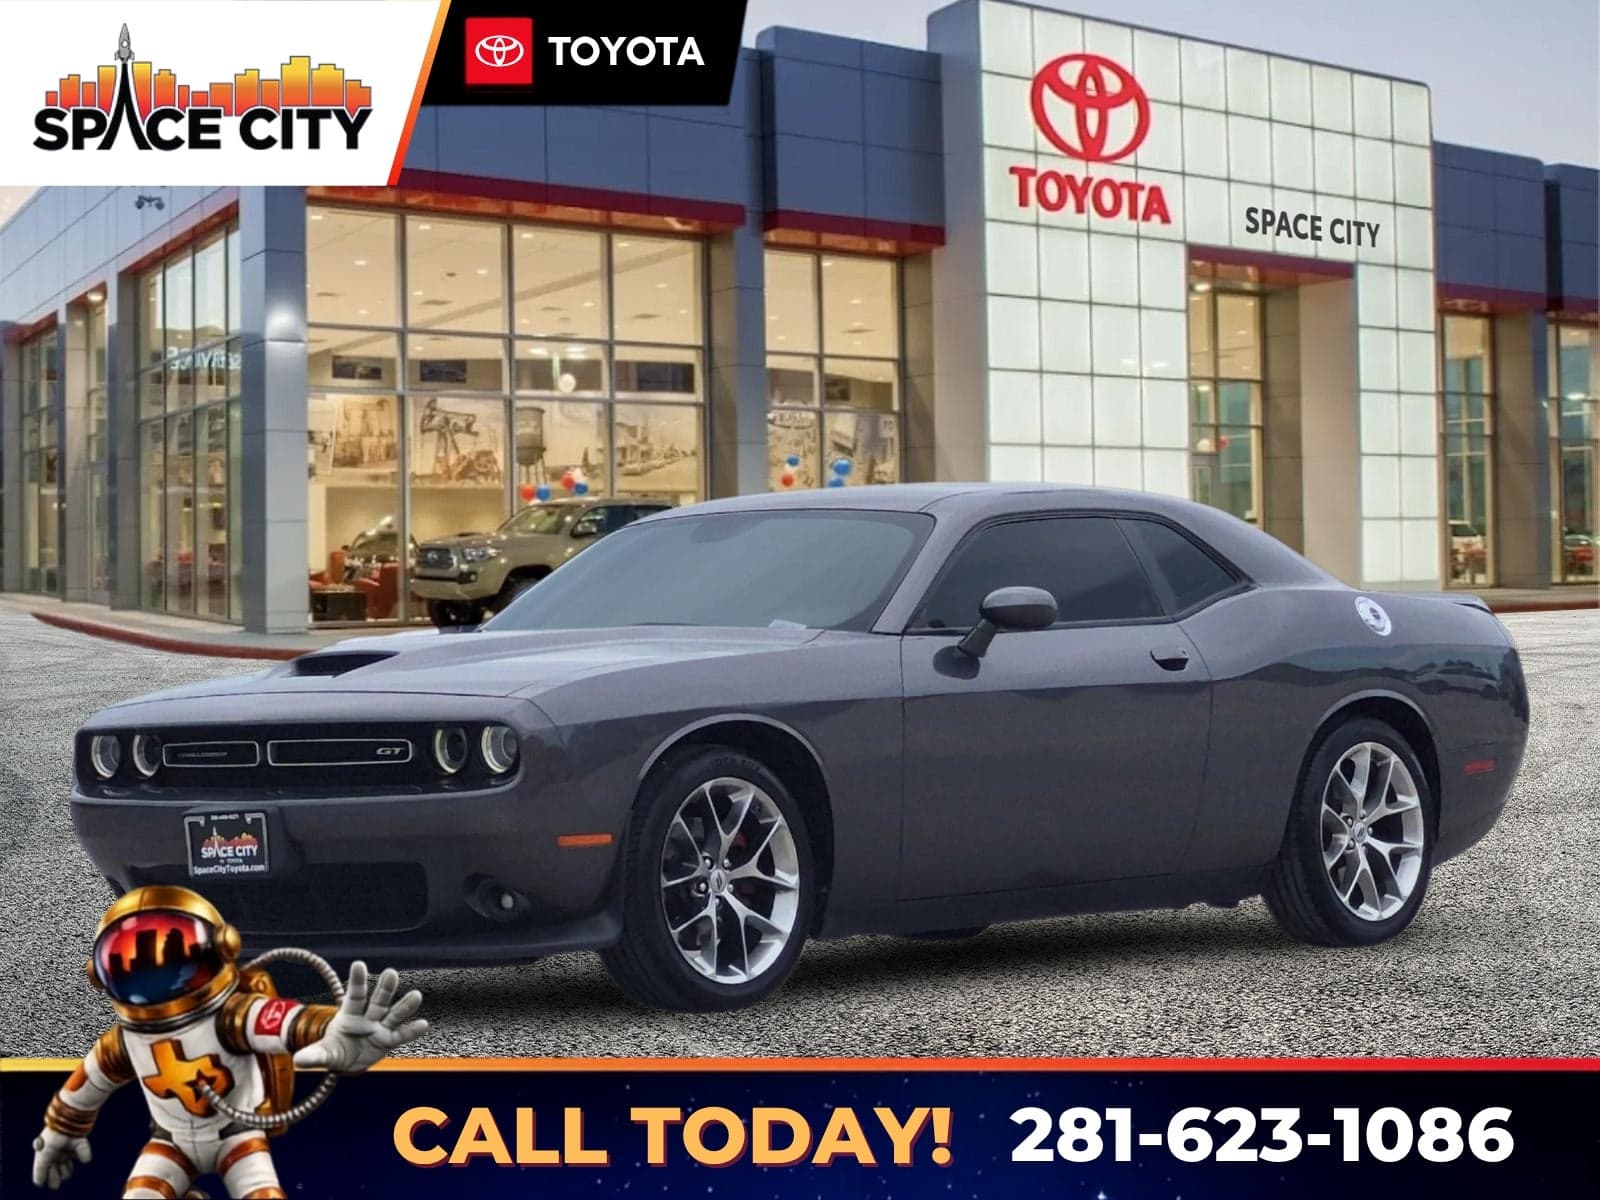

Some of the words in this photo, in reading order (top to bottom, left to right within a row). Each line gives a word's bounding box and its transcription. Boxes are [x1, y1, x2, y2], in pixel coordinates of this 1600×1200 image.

[1009, 166, 1171, 224] TOYOTA
[1244, 206, 1323, 242] SPACE
[1329, 218, 1381, 249] CITY
[376, 747, 405, 755] GT
[201, 844, 234, 858] SPACE
[236, 844, 258, 857] CITY
